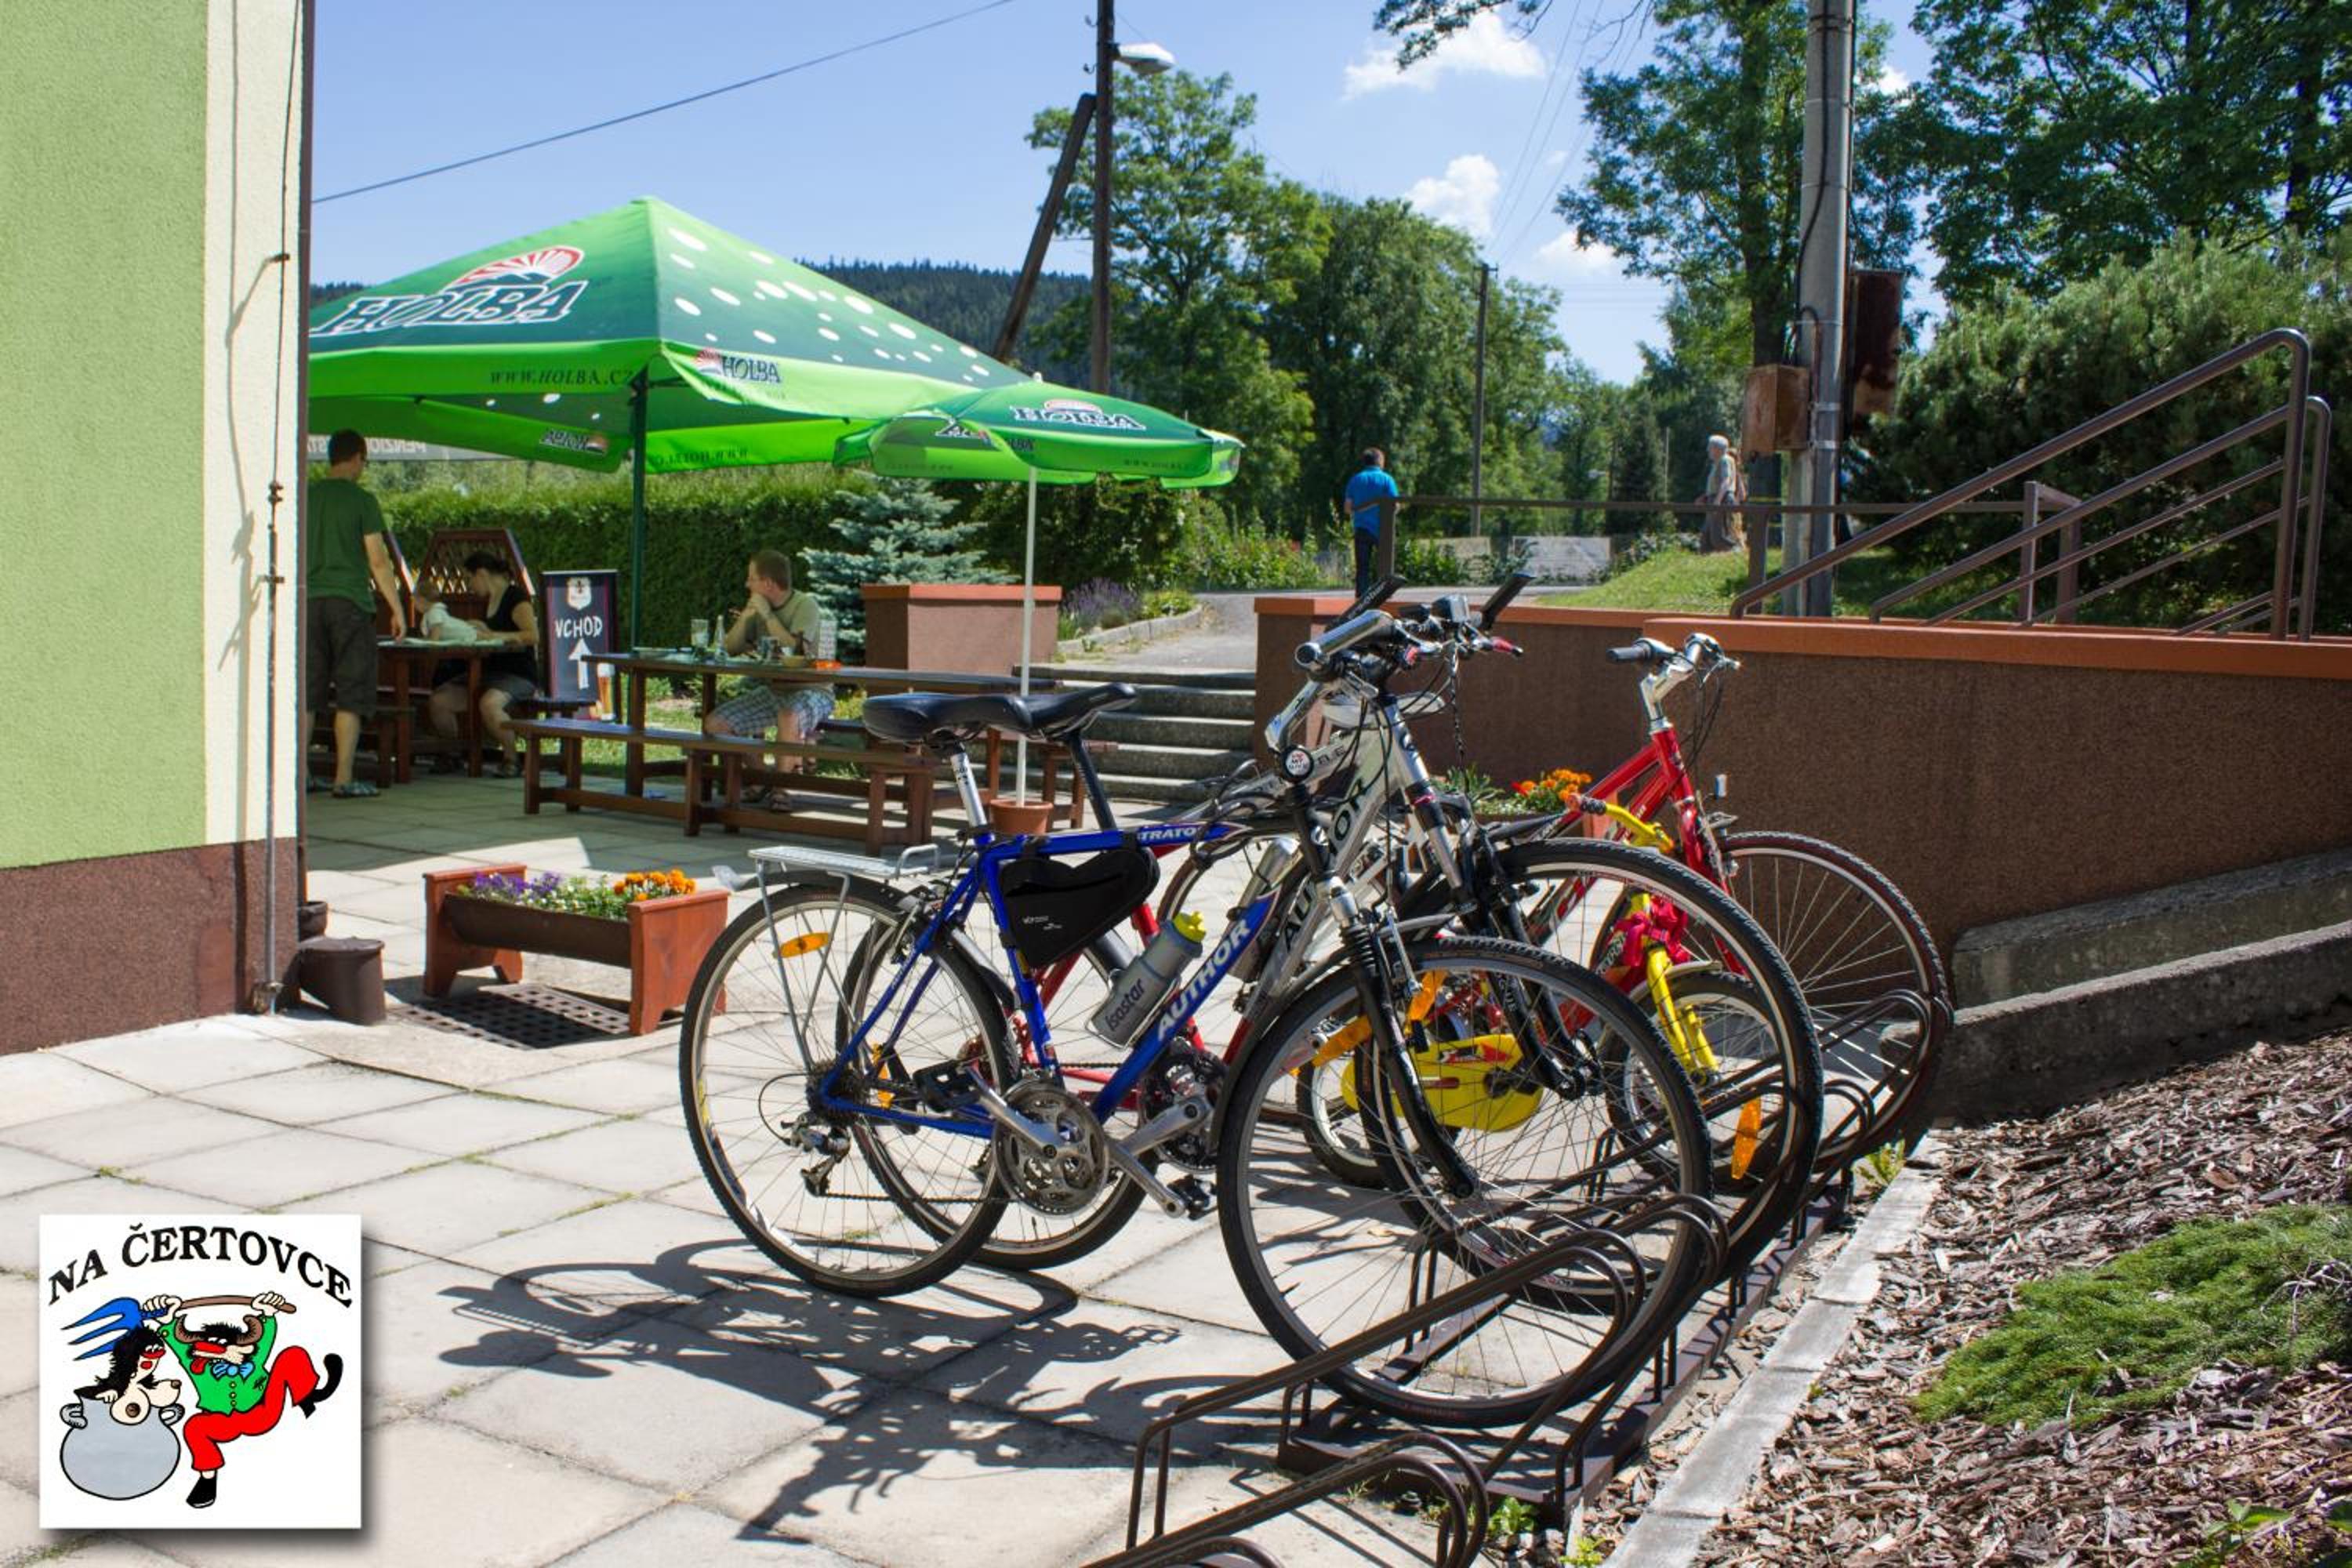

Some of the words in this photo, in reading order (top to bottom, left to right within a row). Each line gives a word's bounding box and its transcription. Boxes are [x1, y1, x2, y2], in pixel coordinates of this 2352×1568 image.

[308, 280, 589, 339] HOLBA
[721, 355, 781, 383] HOLBA
[1009, 405, 1147, 431] HOLBA
[554, 615, 603, 638] VCHOD
[1158, 919, 1252, 1042] AUTHOR
